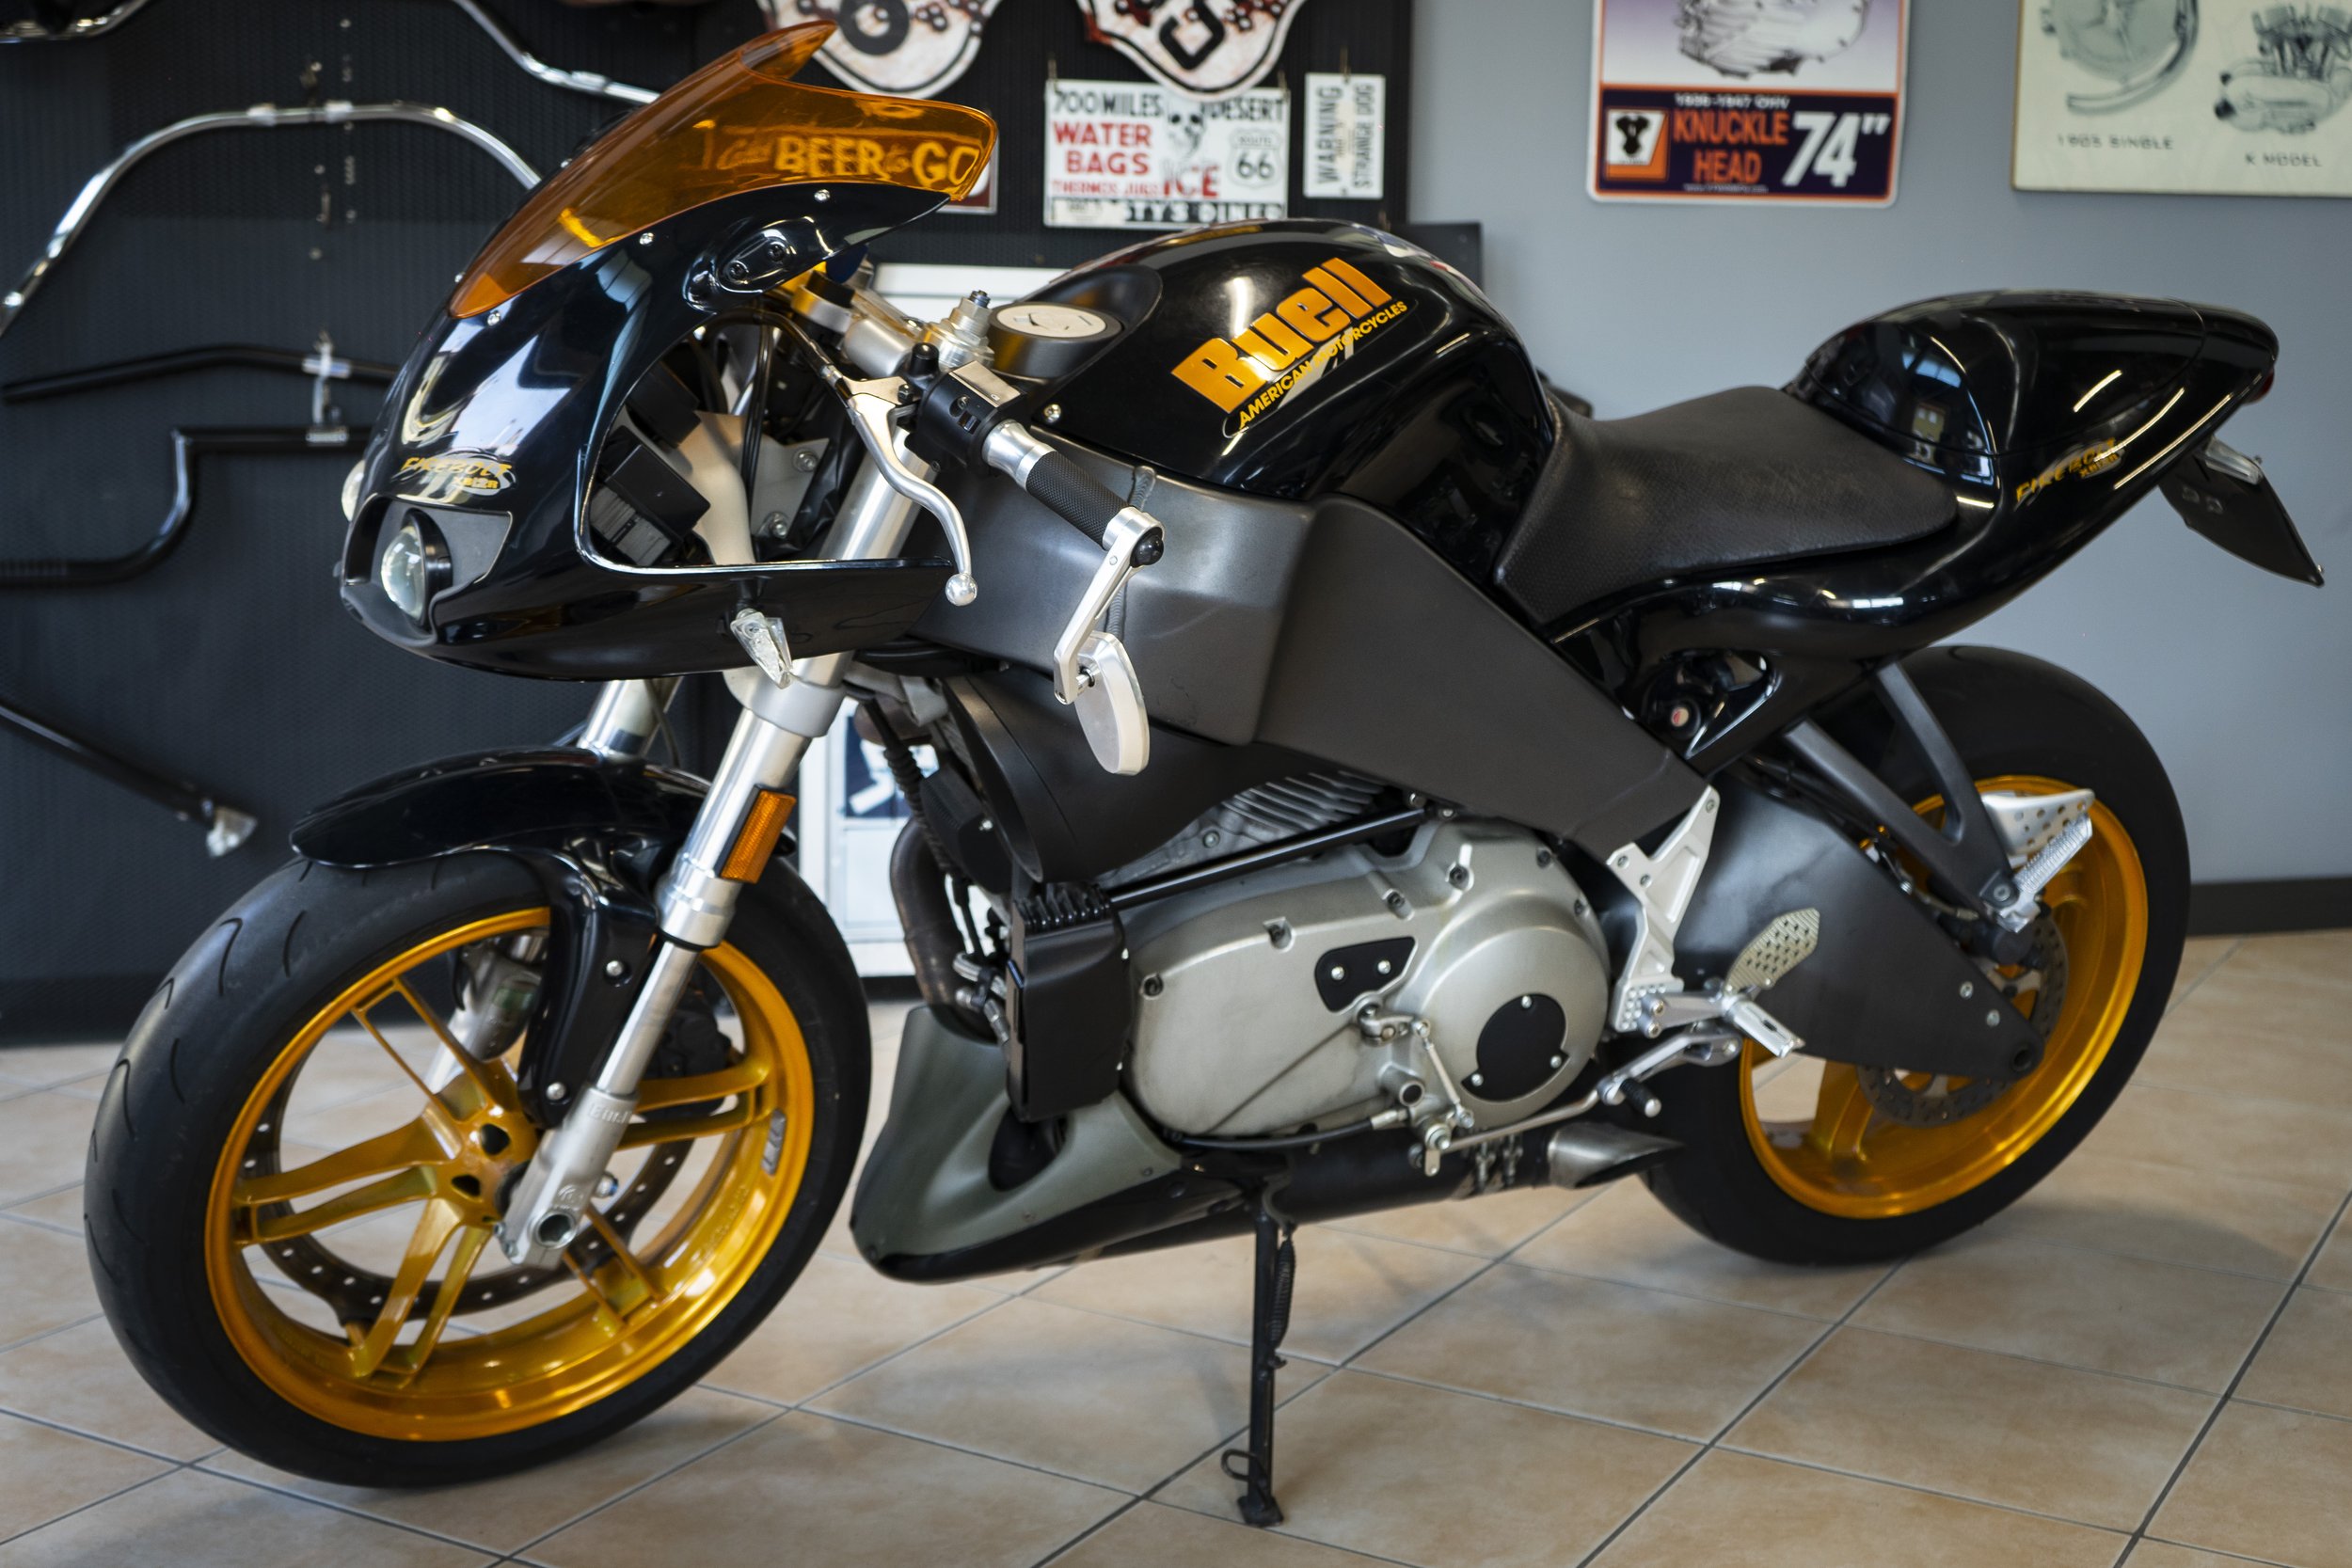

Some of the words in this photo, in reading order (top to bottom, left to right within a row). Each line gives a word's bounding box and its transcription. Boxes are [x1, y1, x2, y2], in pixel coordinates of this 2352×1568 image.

[1053, 91, 1099, 114] 700
[1053, 121, 1152, 147] WATER
[1316, 87, 1343, 184] WARNING
[1674, 109, 1789, 146] KNUCKLE
[774, 137, 890, 179] BEER
[1066, 150, 1151, 176] BAGS
[1237, 151, 1276, 181] 66
[1693, 150, 1763, 185] HEAD
[1171, 257, 1392, 414] Buell
[1238, 360, 1313, 430] AMERICAN
[1313, 301, 1407, 369] MOTORCYCLES
